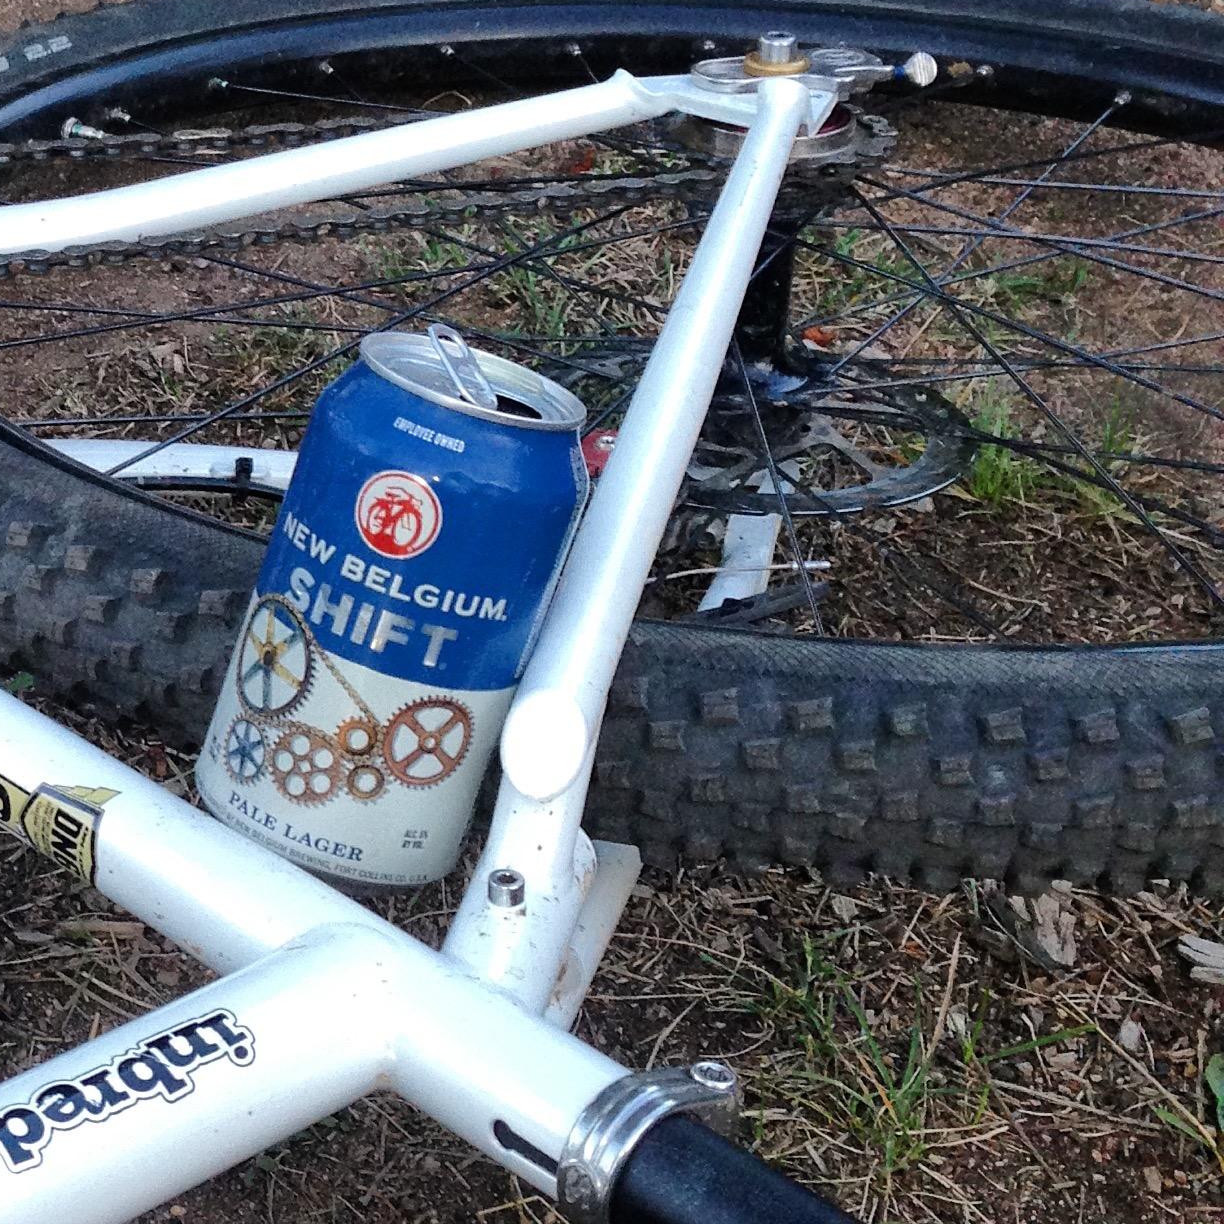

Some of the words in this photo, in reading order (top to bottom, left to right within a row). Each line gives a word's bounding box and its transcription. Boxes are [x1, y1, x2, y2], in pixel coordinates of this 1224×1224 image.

[23, 35, 73, 62] 2.2
[393, 416, 435, 442] EMPLOYEE
[434, 432, 464, 453] OWNED
[283, 511, 337, 565] NEW
[286, 566, 459, 668] SHIFT
[228, 790, 276, 831] PALE
[282, 823, 364, 862] LAGER
